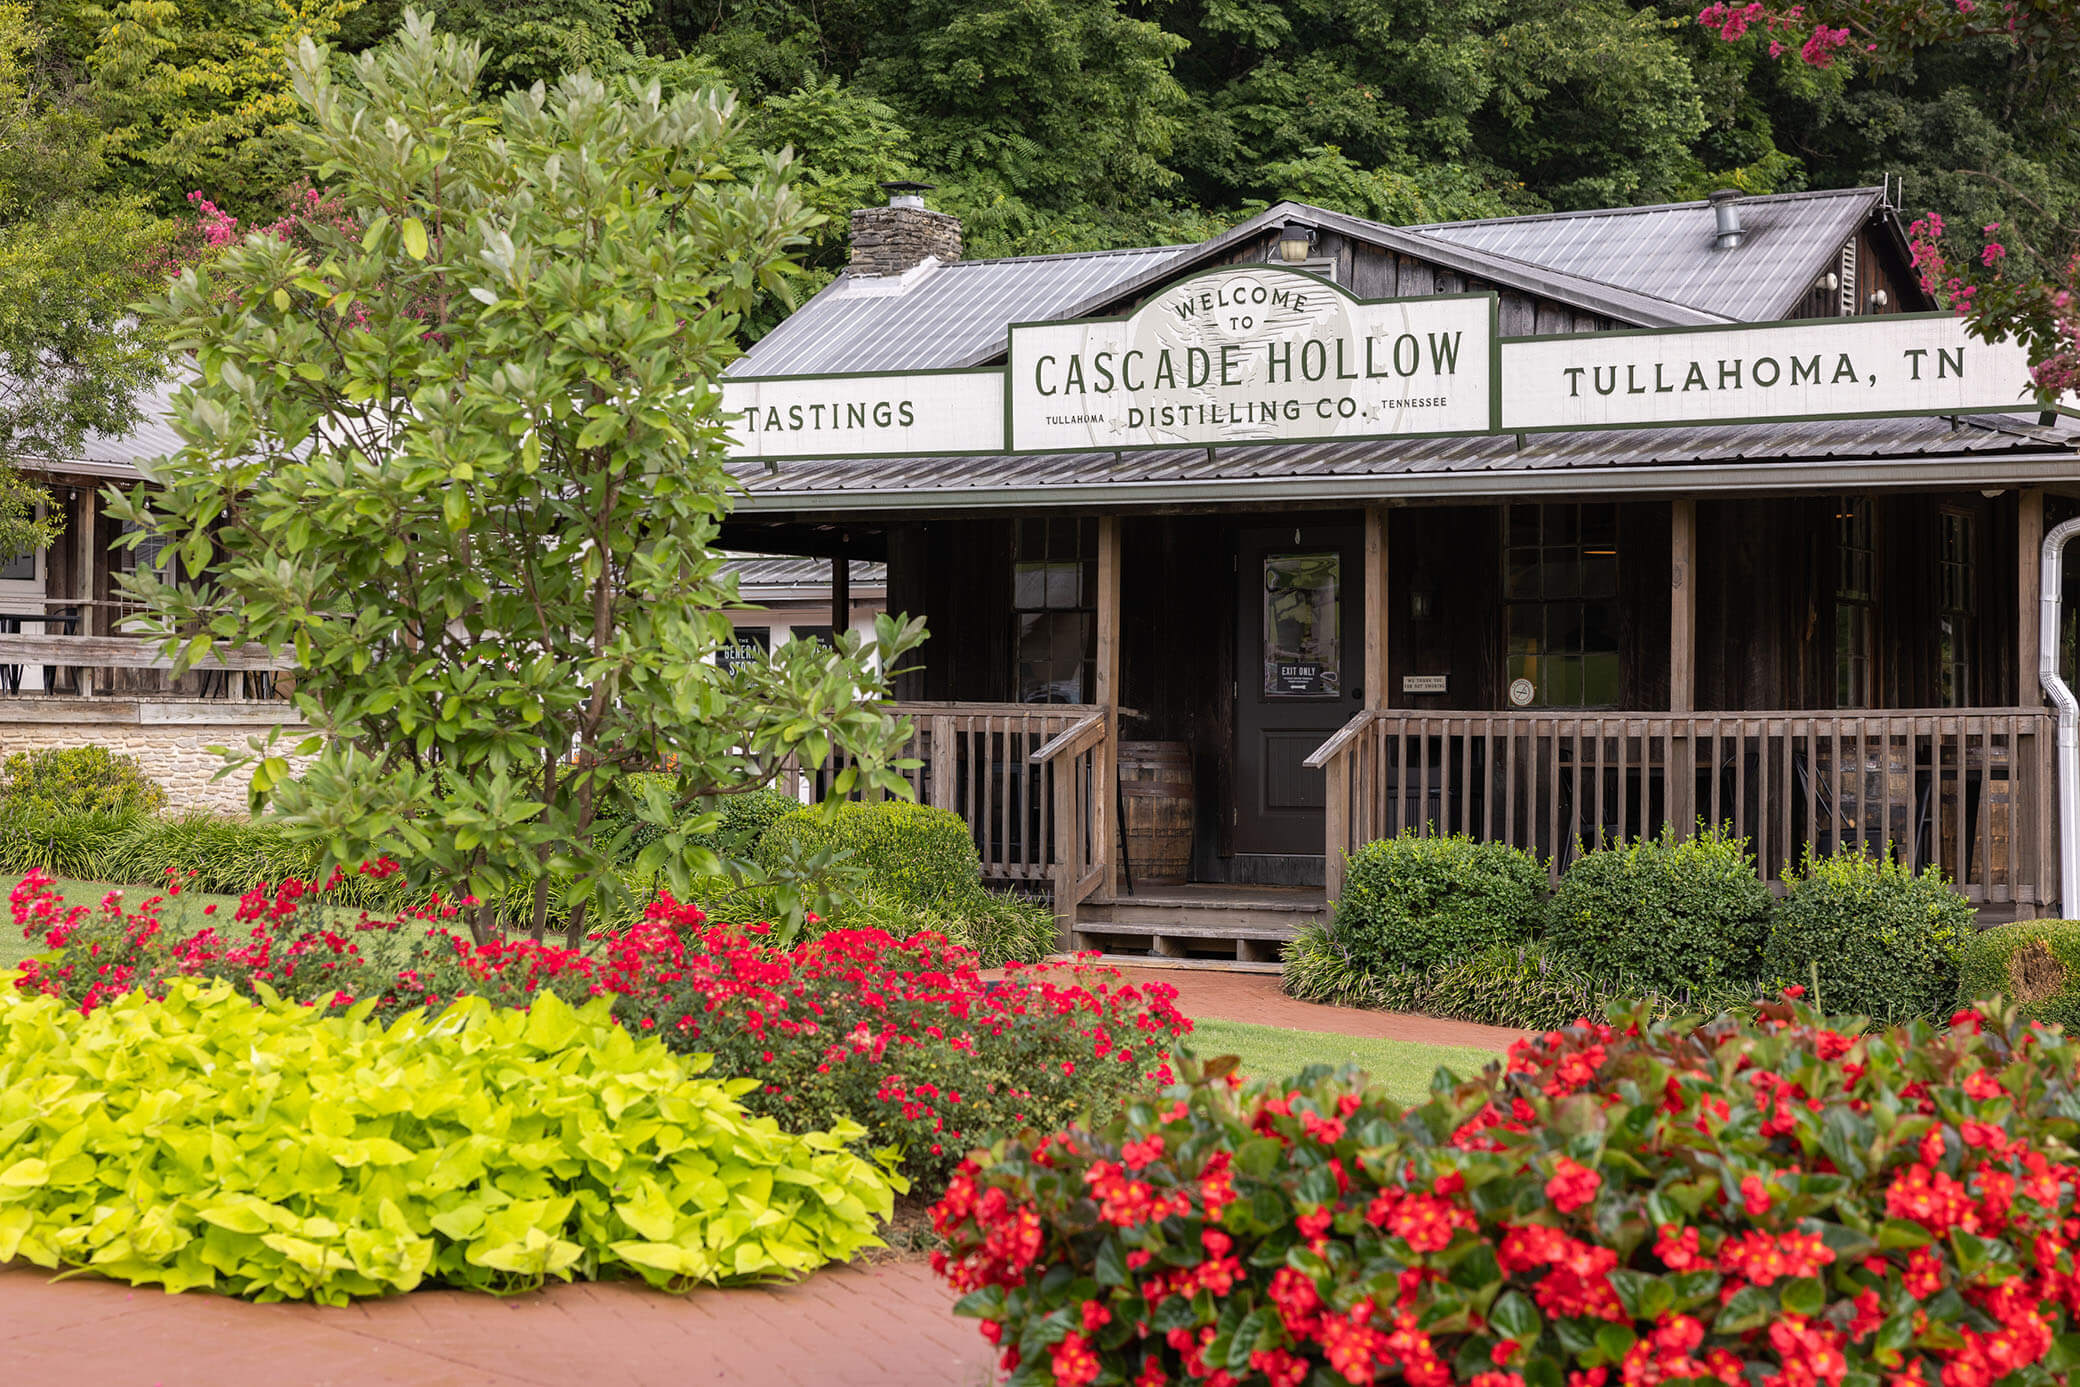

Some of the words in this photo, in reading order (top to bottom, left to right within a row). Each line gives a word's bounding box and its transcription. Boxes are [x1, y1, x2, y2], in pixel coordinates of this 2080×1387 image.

[1176, 286, 1308, 320] WELCOME
[1229, 315, 1254, 331] TO
[1035, 344, 1243, 397] CASCADE
[1267, 331, 1463, 384] HOLLOW
[1563, 353, 1878, 397] TULLAHOMA,
[1903, 346, 1966, 381] TN
[743, 400, 915, 433] TASTINGS
[1128, 401, 1301, 429] DISTILLING
[1316, 397, 1368, 419] CO.
[1381, 397, 1448, 409] TENNESSEE
[1046, 414, 1105, 426] TULLAHOMA
[1281, 666, 1297, 676] EXIT
[1298, 666, 1316, 676] ONLY
